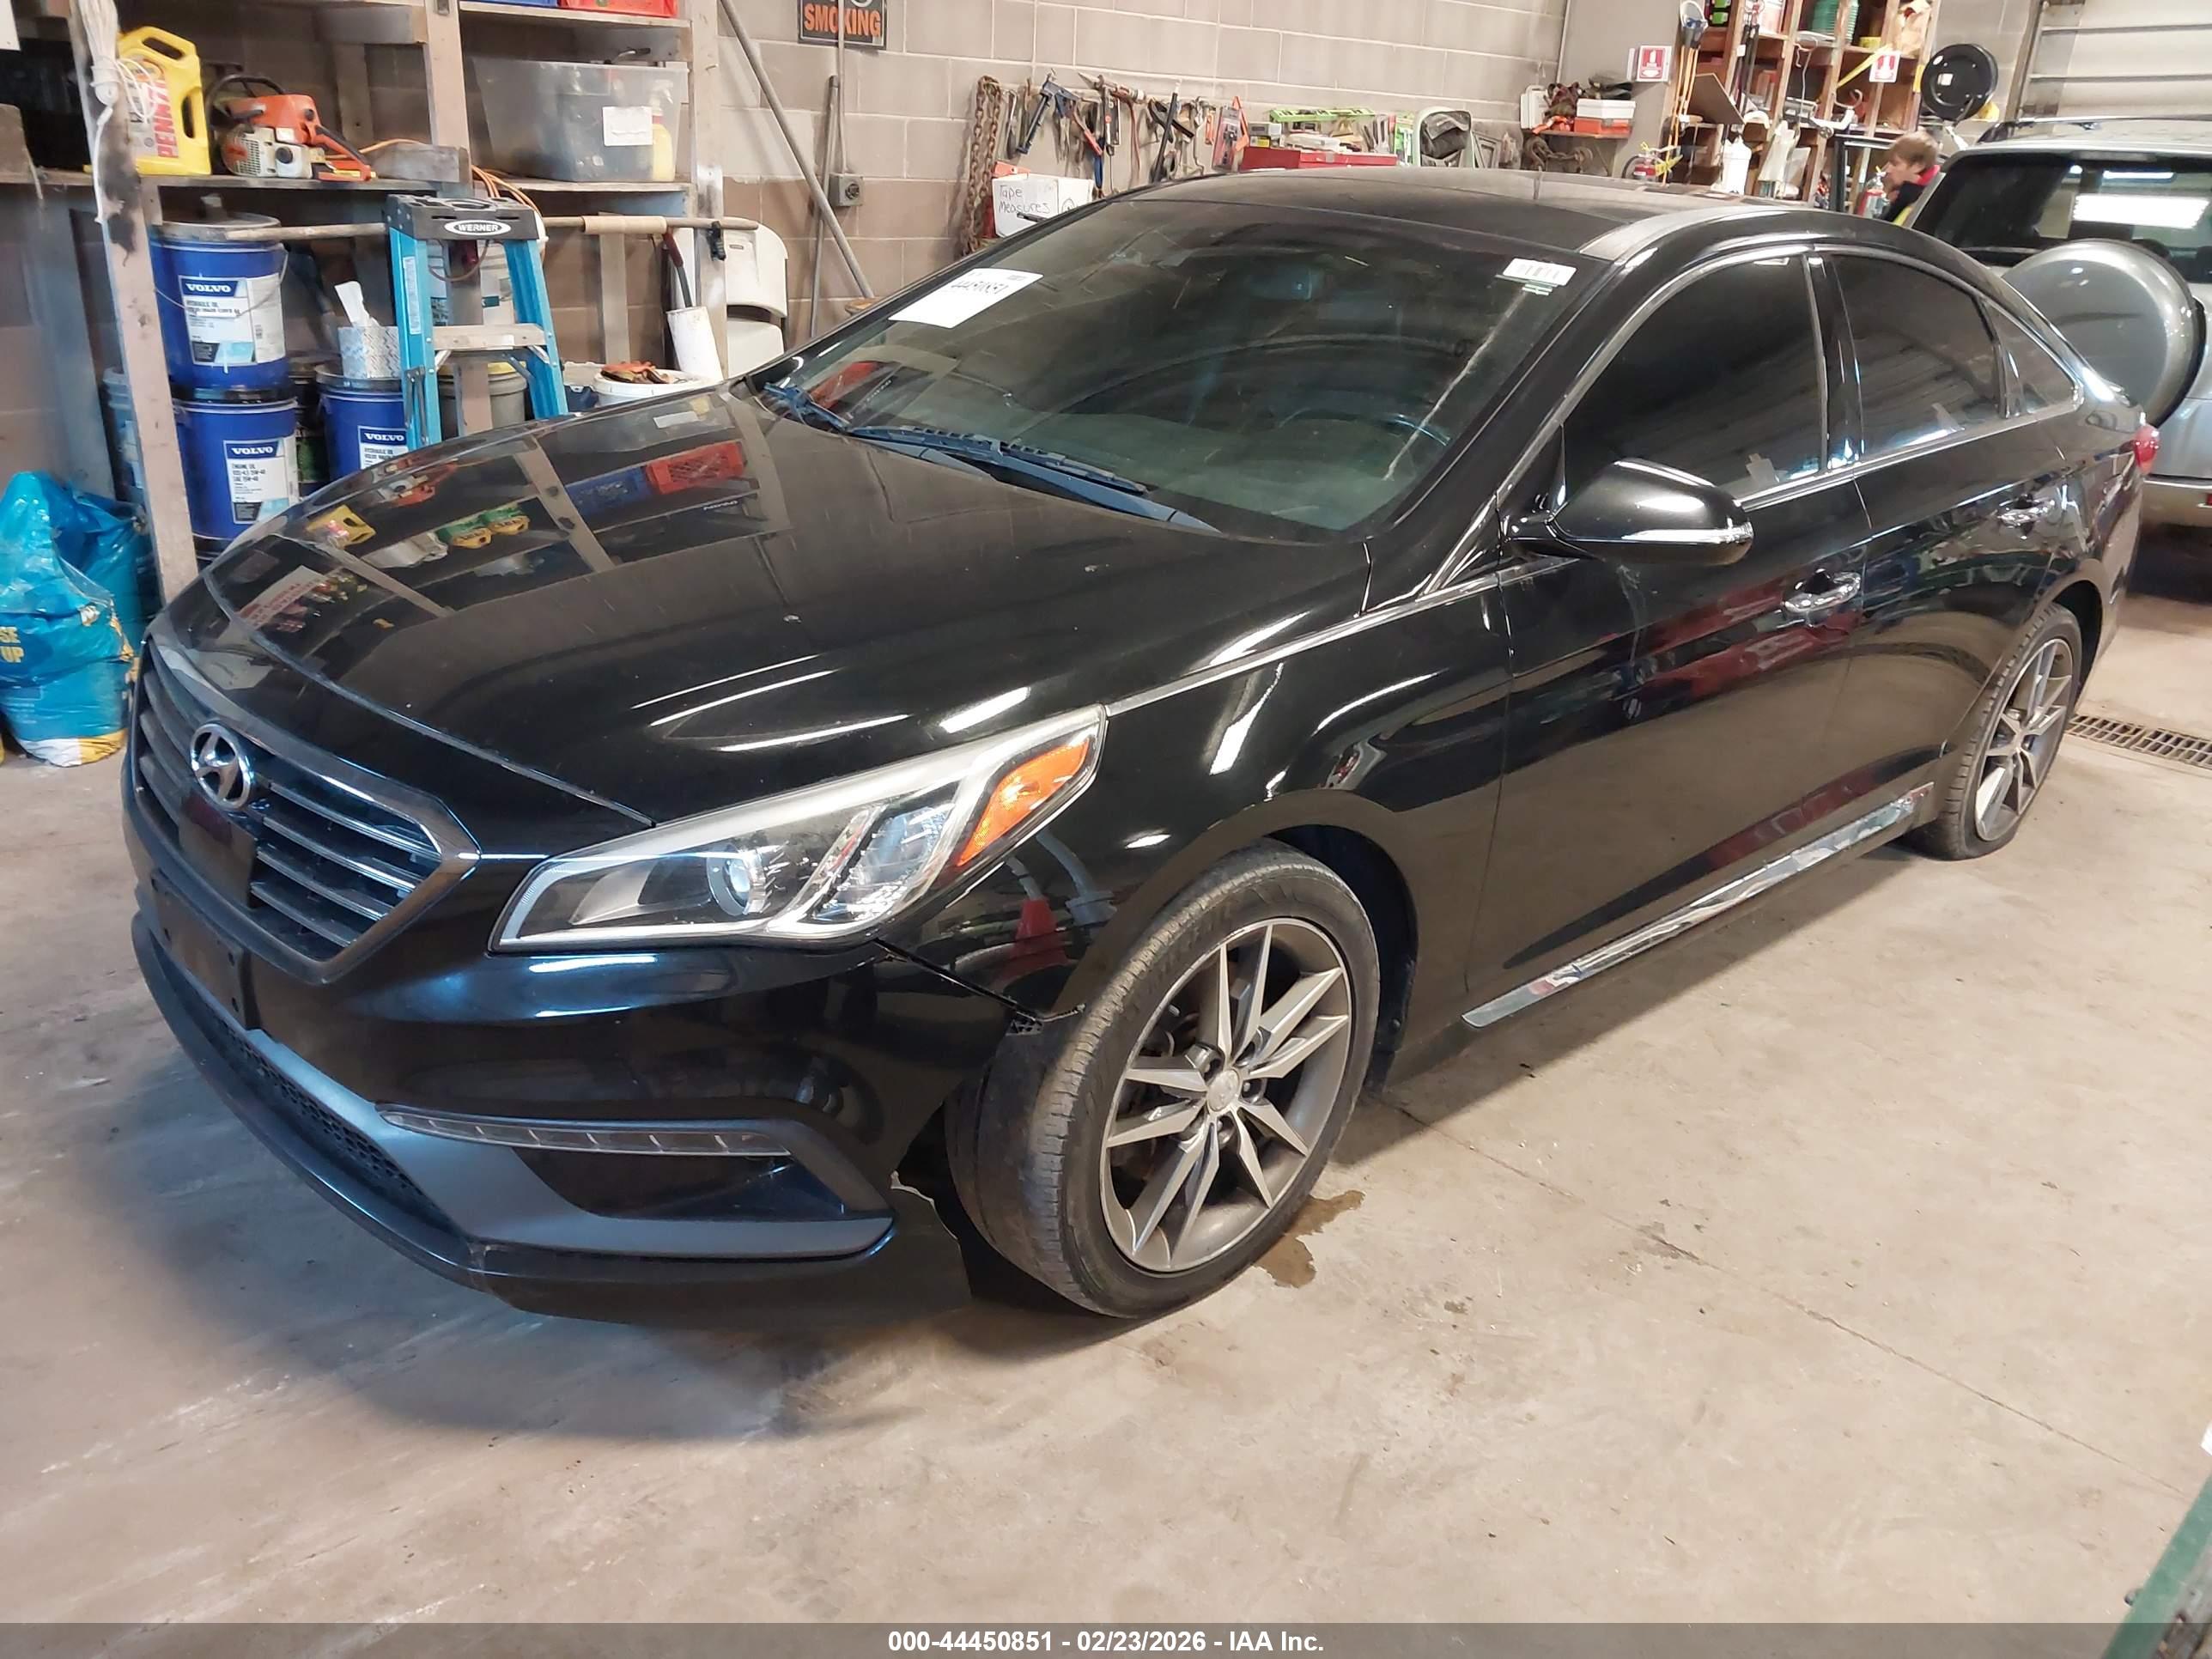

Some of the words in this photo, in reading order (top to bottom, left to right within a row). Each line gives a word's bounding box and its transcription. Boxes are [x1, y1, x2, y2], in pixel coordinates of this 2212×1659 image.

[804, 3, 881, 37] SMOKING
[1000, 185, 1023, 200] Tape
[457, 223, 501, 232] WERNER
[185, 283, 232, 293] VOLVO
[363, 432, 405, 441] VOLVO
[231, 446, 274, 455] VOLVO
[1, 646, 25, 663] UP
